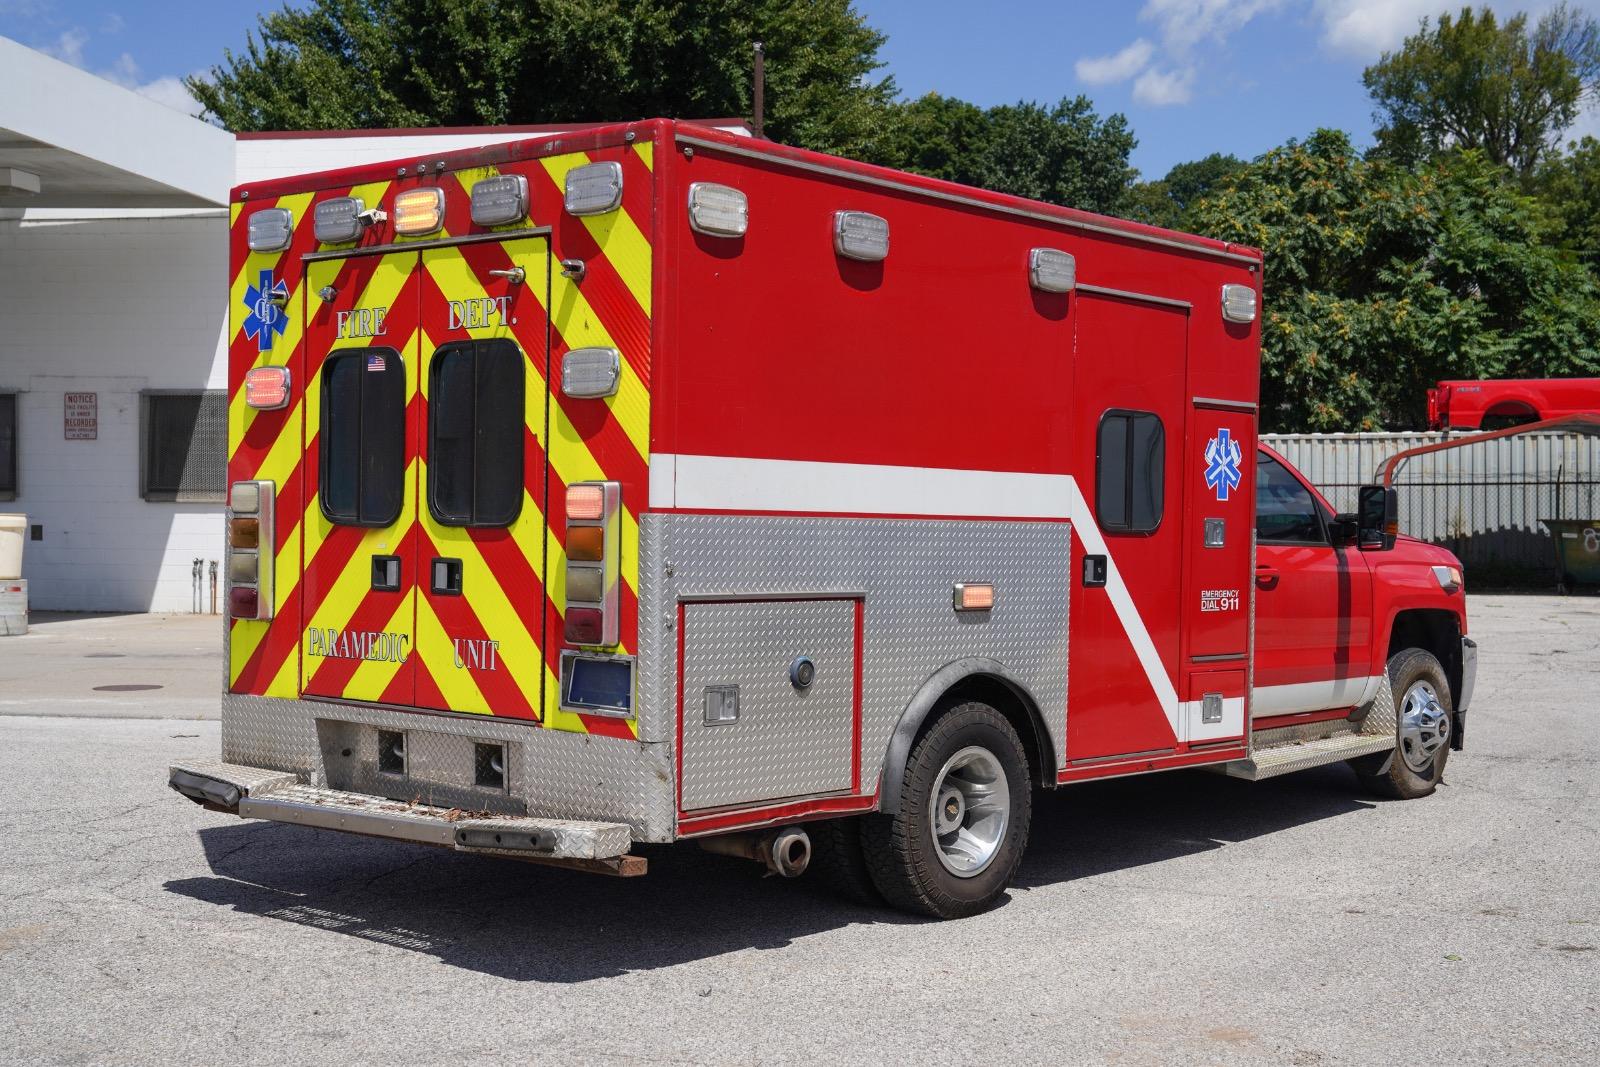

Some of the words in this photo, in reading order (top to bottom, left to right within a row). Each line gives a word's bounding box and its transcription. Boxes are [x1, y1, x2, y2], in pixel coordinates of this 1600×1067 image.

[335, 307, 387, 339] FIRE
[447, 296, 518, 330] DEPT.
[68, 395, 94, 403] NOTICE
[65, 418, 97, 427] RECORDED
[1201, 590, 1240, 598] EMERGENCY
[1201, 600, 1220, 609] DIAL
[1220, 598, 1239, 610] 911
[308, 627, 409, 663] PARAMEDIC
[453, 638, 500, 671] UNIT
